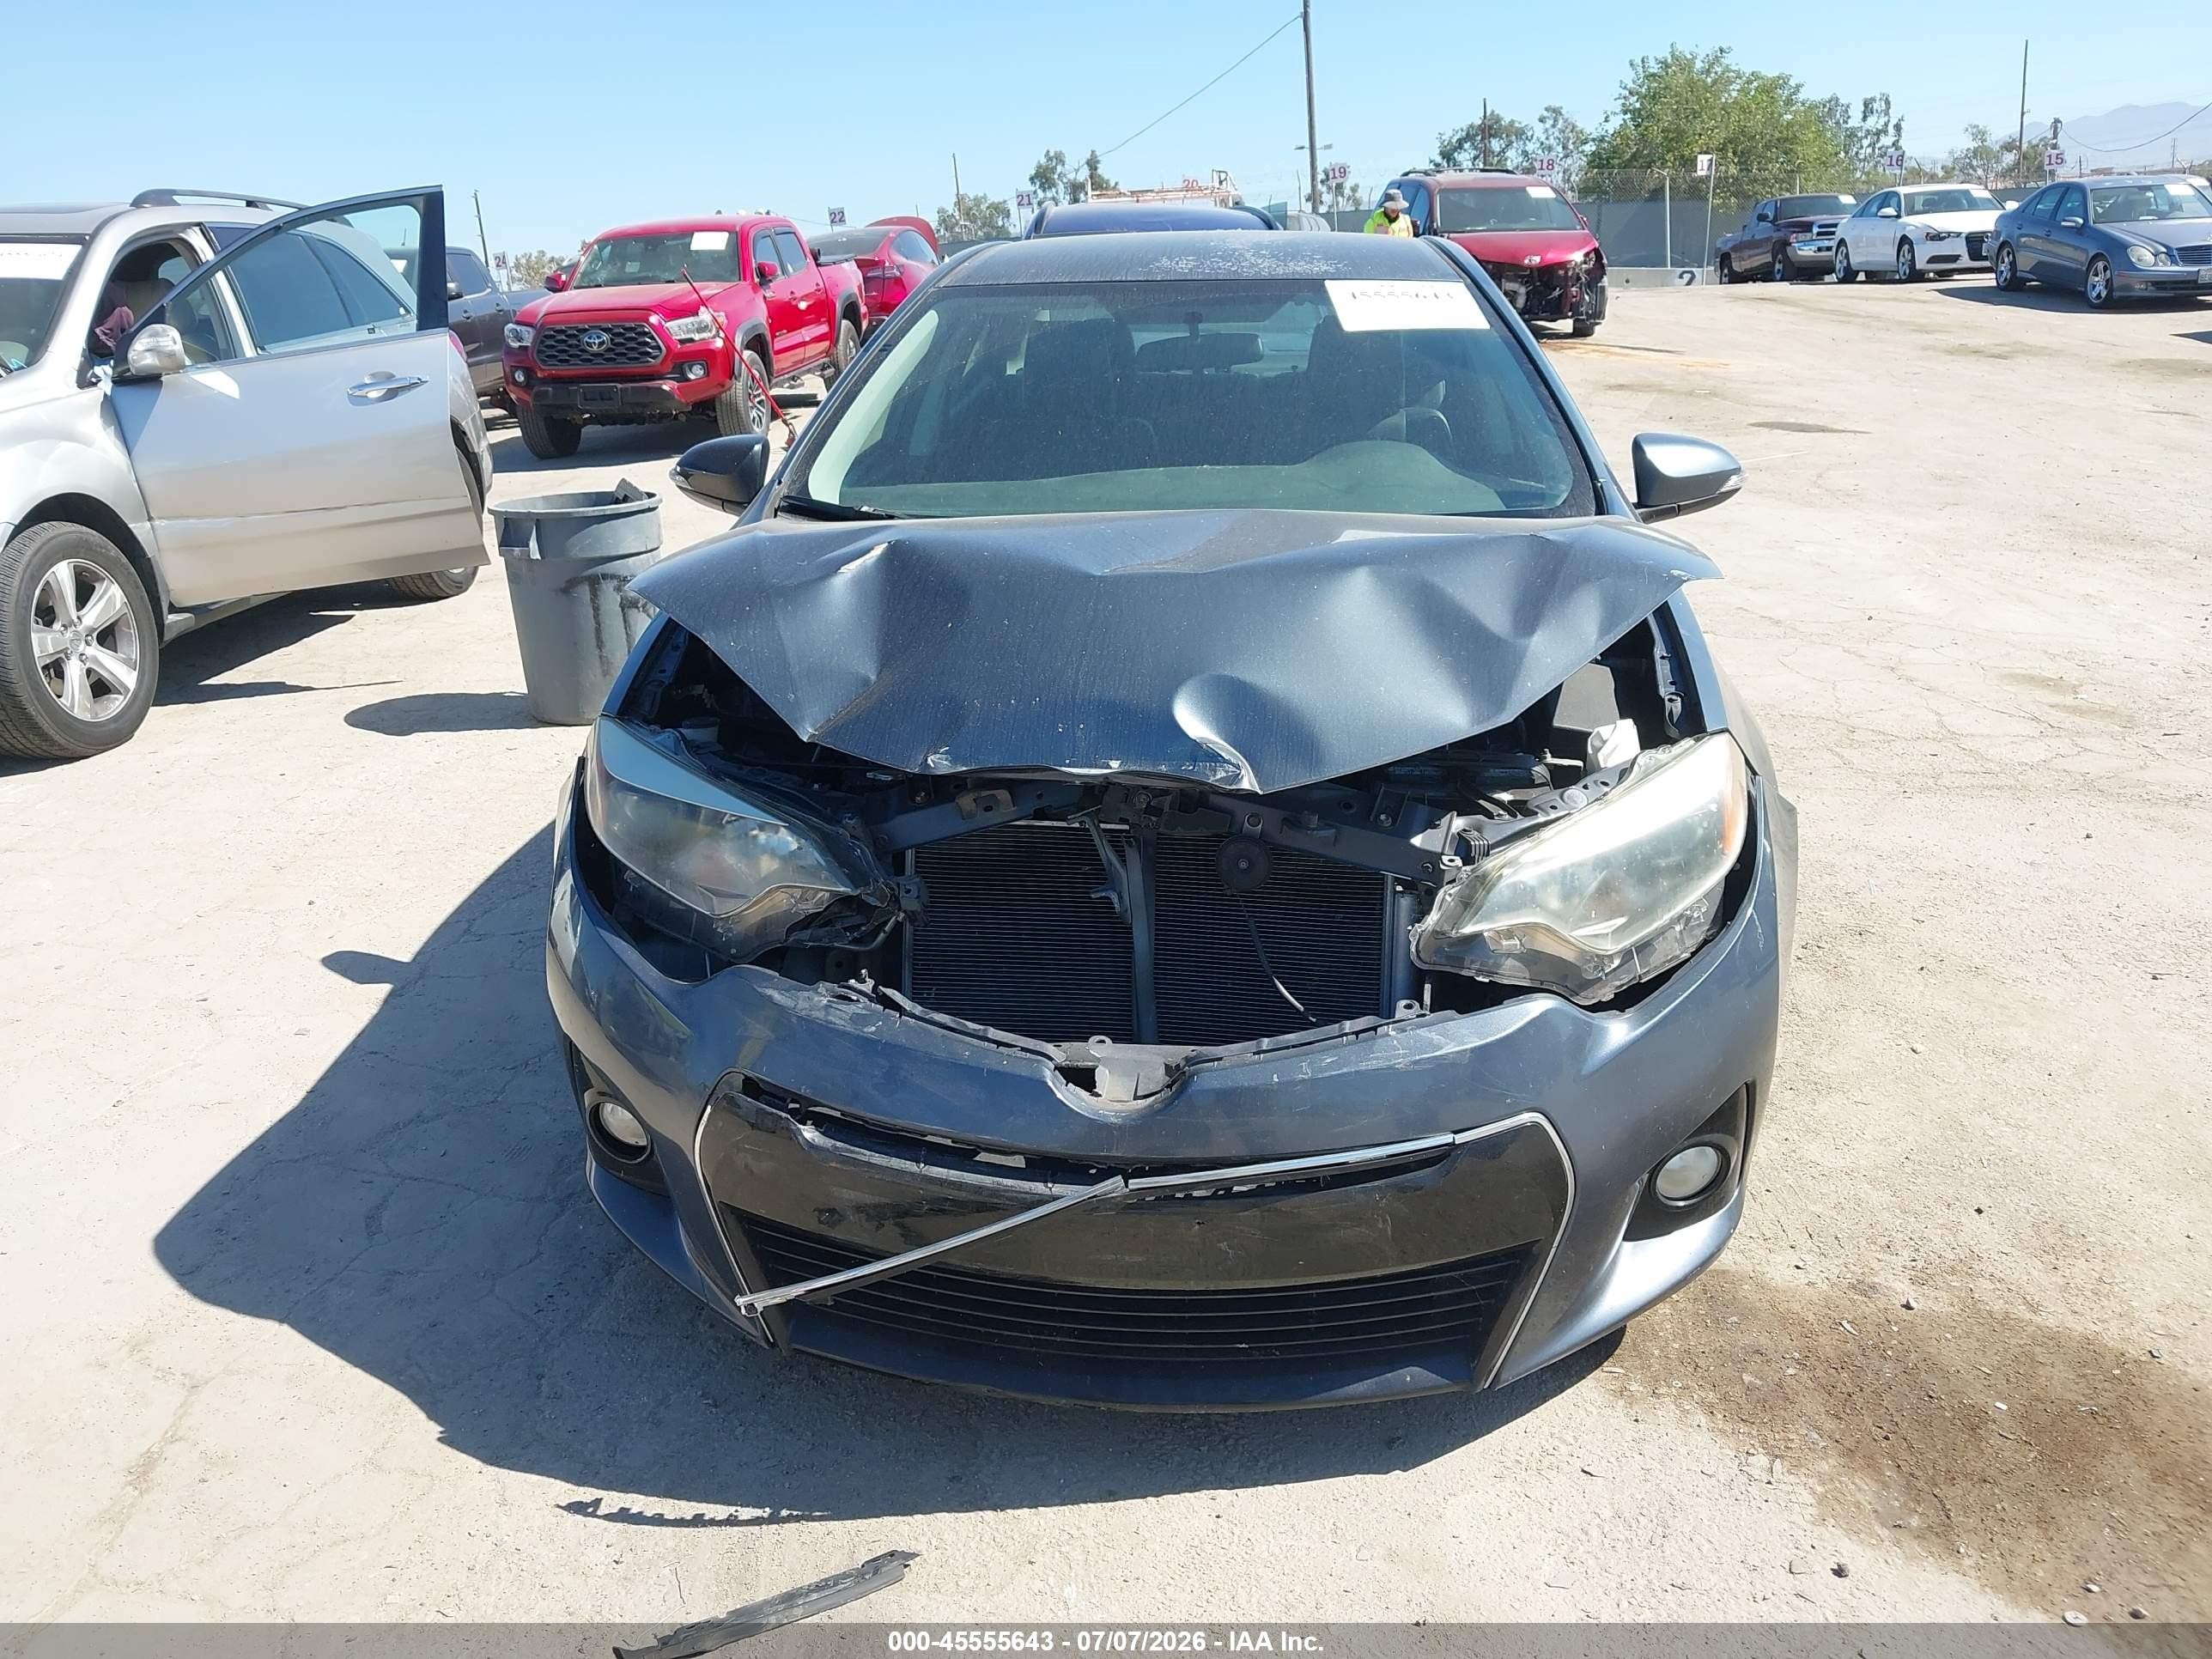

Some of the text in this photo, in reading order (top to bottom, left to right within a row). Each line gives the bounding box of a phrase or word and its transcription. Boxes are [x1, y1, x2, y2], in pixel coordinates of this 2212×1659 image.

[1537, 158, 1555, 171] 18
[1886, 155, 1904, 167] 16
[2045, 153, 2064, 167] 15
[1330, 166, 1347, 179] 19
[1016, 193, 1033, 207] 21
[830, 210, 846, 224] 22
[494, 253, 507, 268] 24
